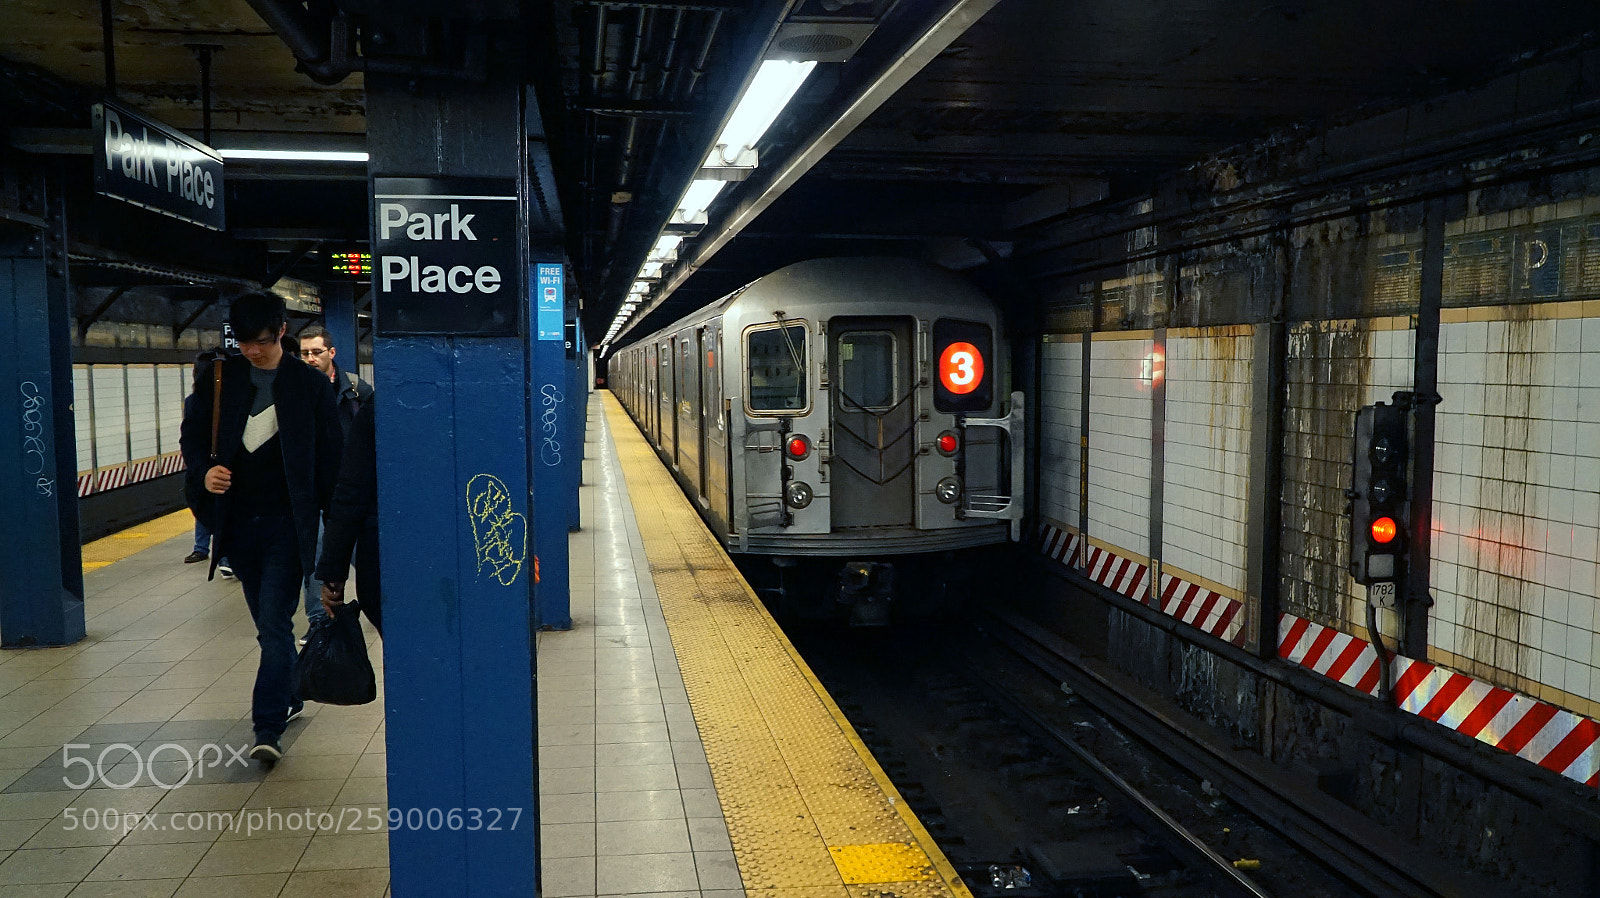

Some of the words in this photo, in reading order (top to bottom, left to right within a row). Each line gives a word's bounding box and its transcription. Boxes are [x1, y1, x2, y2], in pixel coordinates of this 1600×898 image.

[105, 107, 158, 188] Park
[165, 138, 214, 209] Place
[380, 203, 477, 240] Park
[381, 255, 501, 293] Place
[540, 267, 560, 275] FREE
[1521, 239, 1549, 289] P
[540, 276, 560, 284] WI-FI
[224, 338, 240, 349] Pla
[949, 351, 974, 385] 3
[1373, 585, 1393, 595] 1782
[1379, 595, 1386, 606] K
